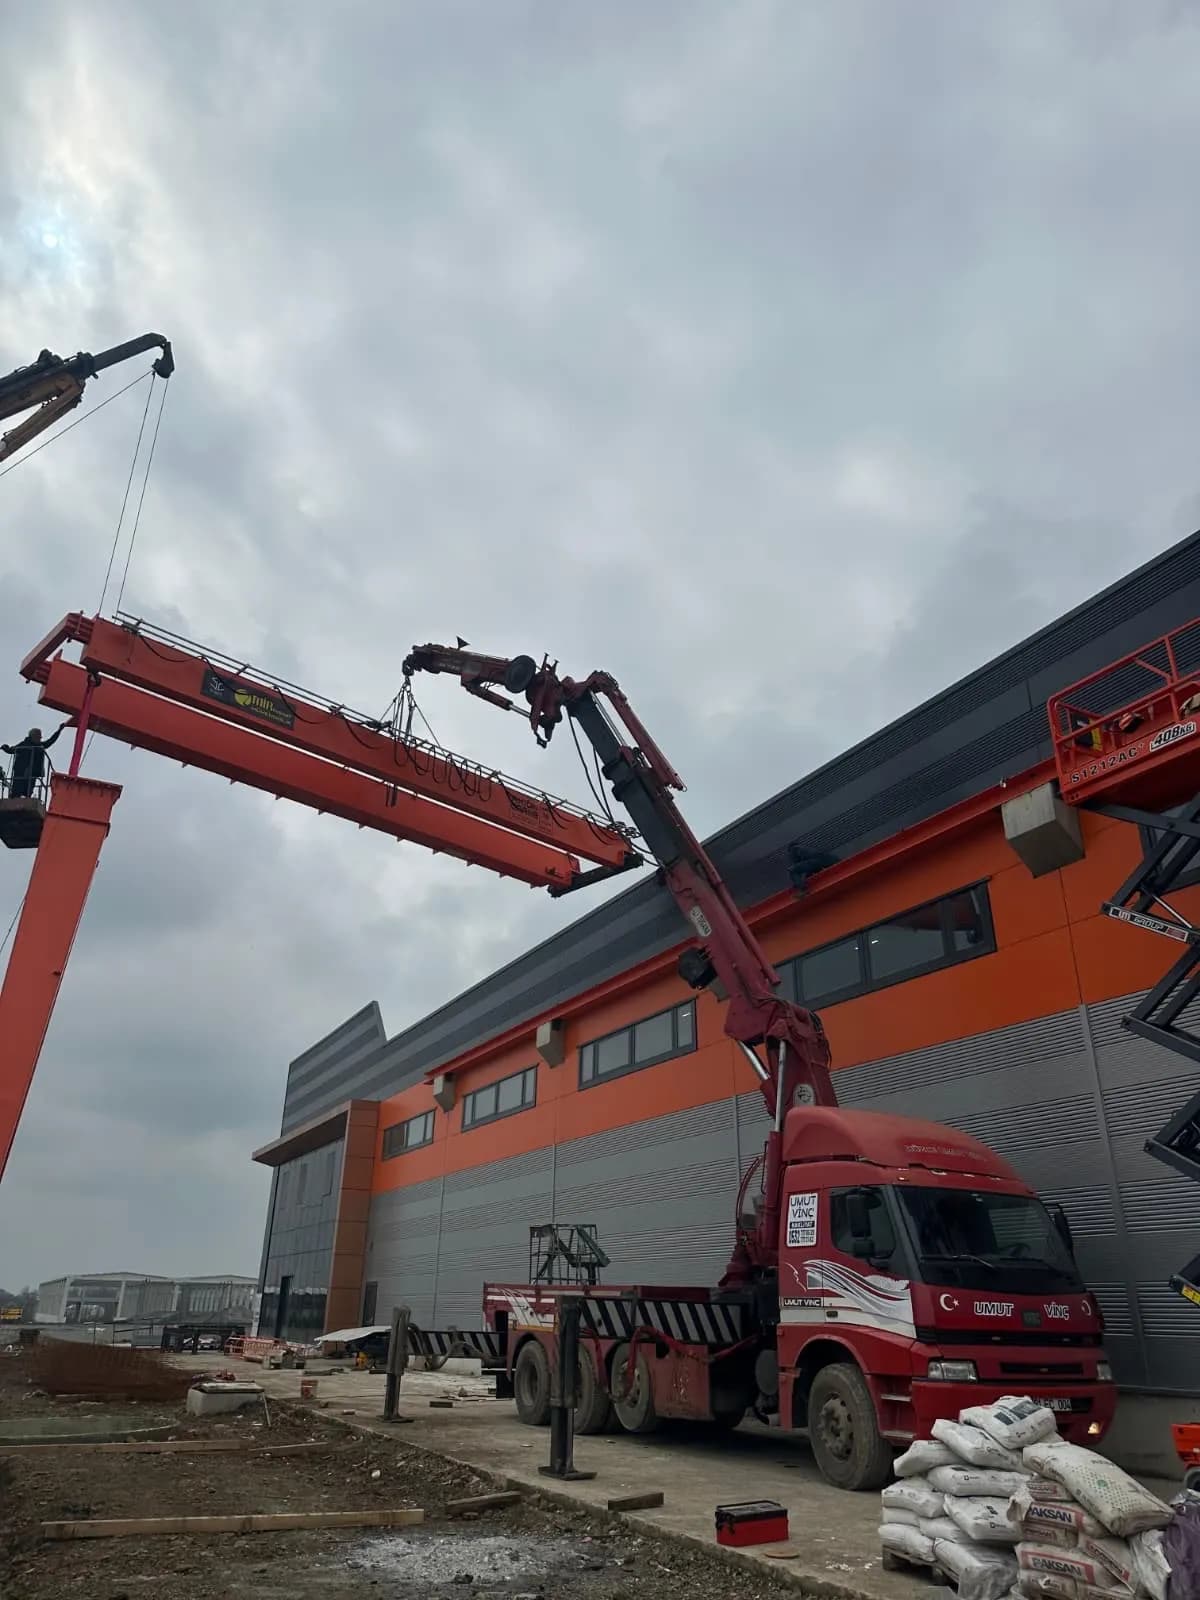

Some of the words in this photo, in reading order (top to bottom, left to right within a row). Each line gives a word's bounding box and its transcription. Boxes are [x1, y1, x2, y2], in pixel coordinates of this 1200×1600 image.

[1133, 916, 1164, 931] GROUP
[790, 1196, 816, 1207] UMUT
[974, 1301, 1014, 1317] UMUT
[1044, 1301, 1070, 1320] VİNÇ
[1029, 1506, 1072, 1523] AKSAN
[1031, 1557, 1082, 1576] PAKSAN
